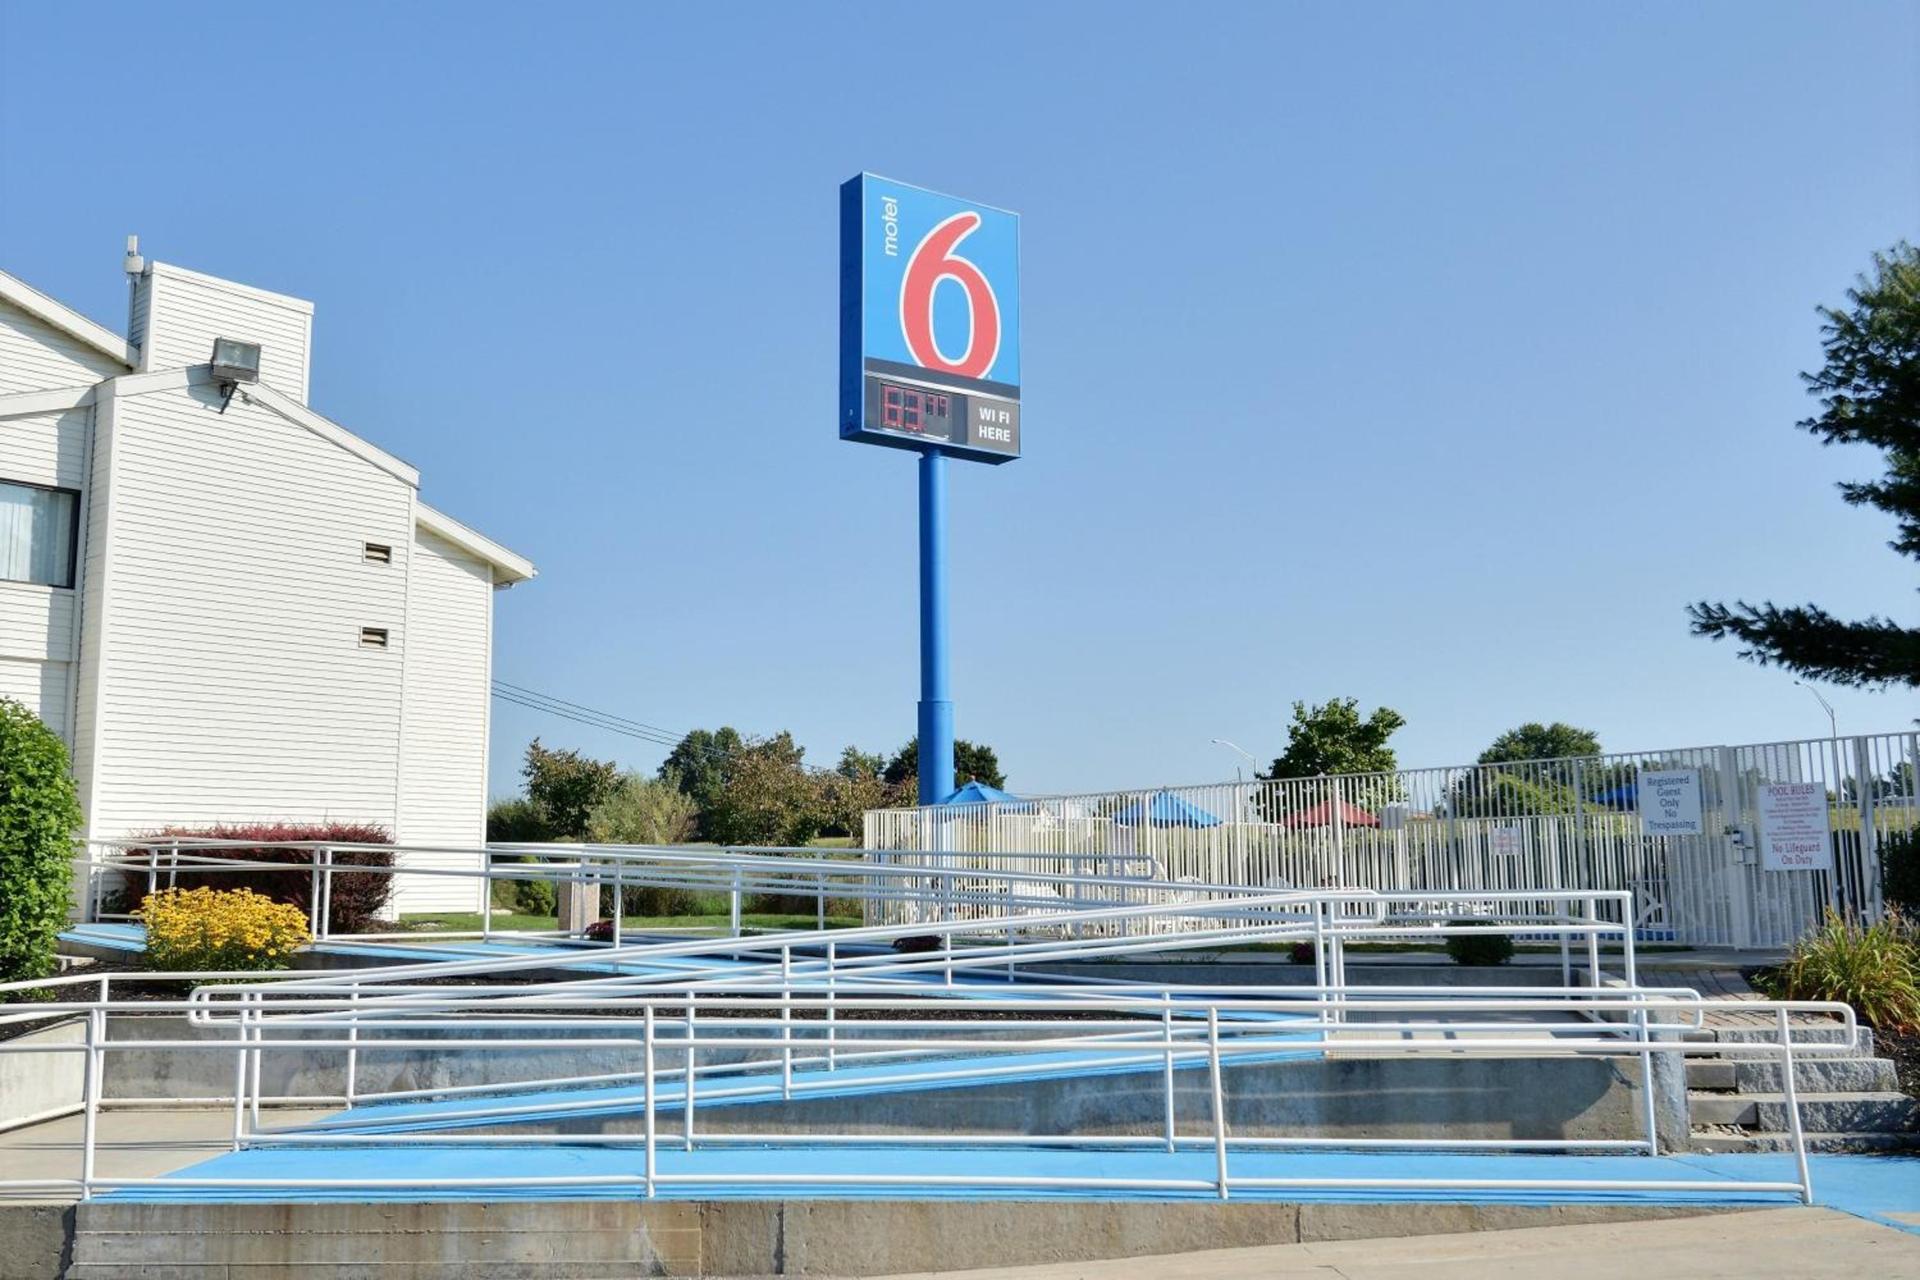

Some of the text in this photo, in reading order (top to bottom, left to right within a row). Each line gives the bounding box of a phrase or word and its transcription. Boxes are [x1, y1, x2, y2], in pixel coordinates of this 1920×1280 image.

[881, 196, 898, 257] motel
[900, 211, 1001, 379] 6
[978, 407, 1010, 424] WI FI
[978, 424, 1011, 442] HERE
[1647, 775, 1689, 787] Registered
[1656, 787, 1681, 797] Guest
[1767, 784, 1815, 797] POOL RULES
[1659, 798, 1679, 809] Only
[1664, 809, 1677, 818] No
[1648, 820, 1697, 831] Trespassing
[1771, 841, 1821, 854] No Lifeguard
[1781, 854, 1813, 867] On Duty
